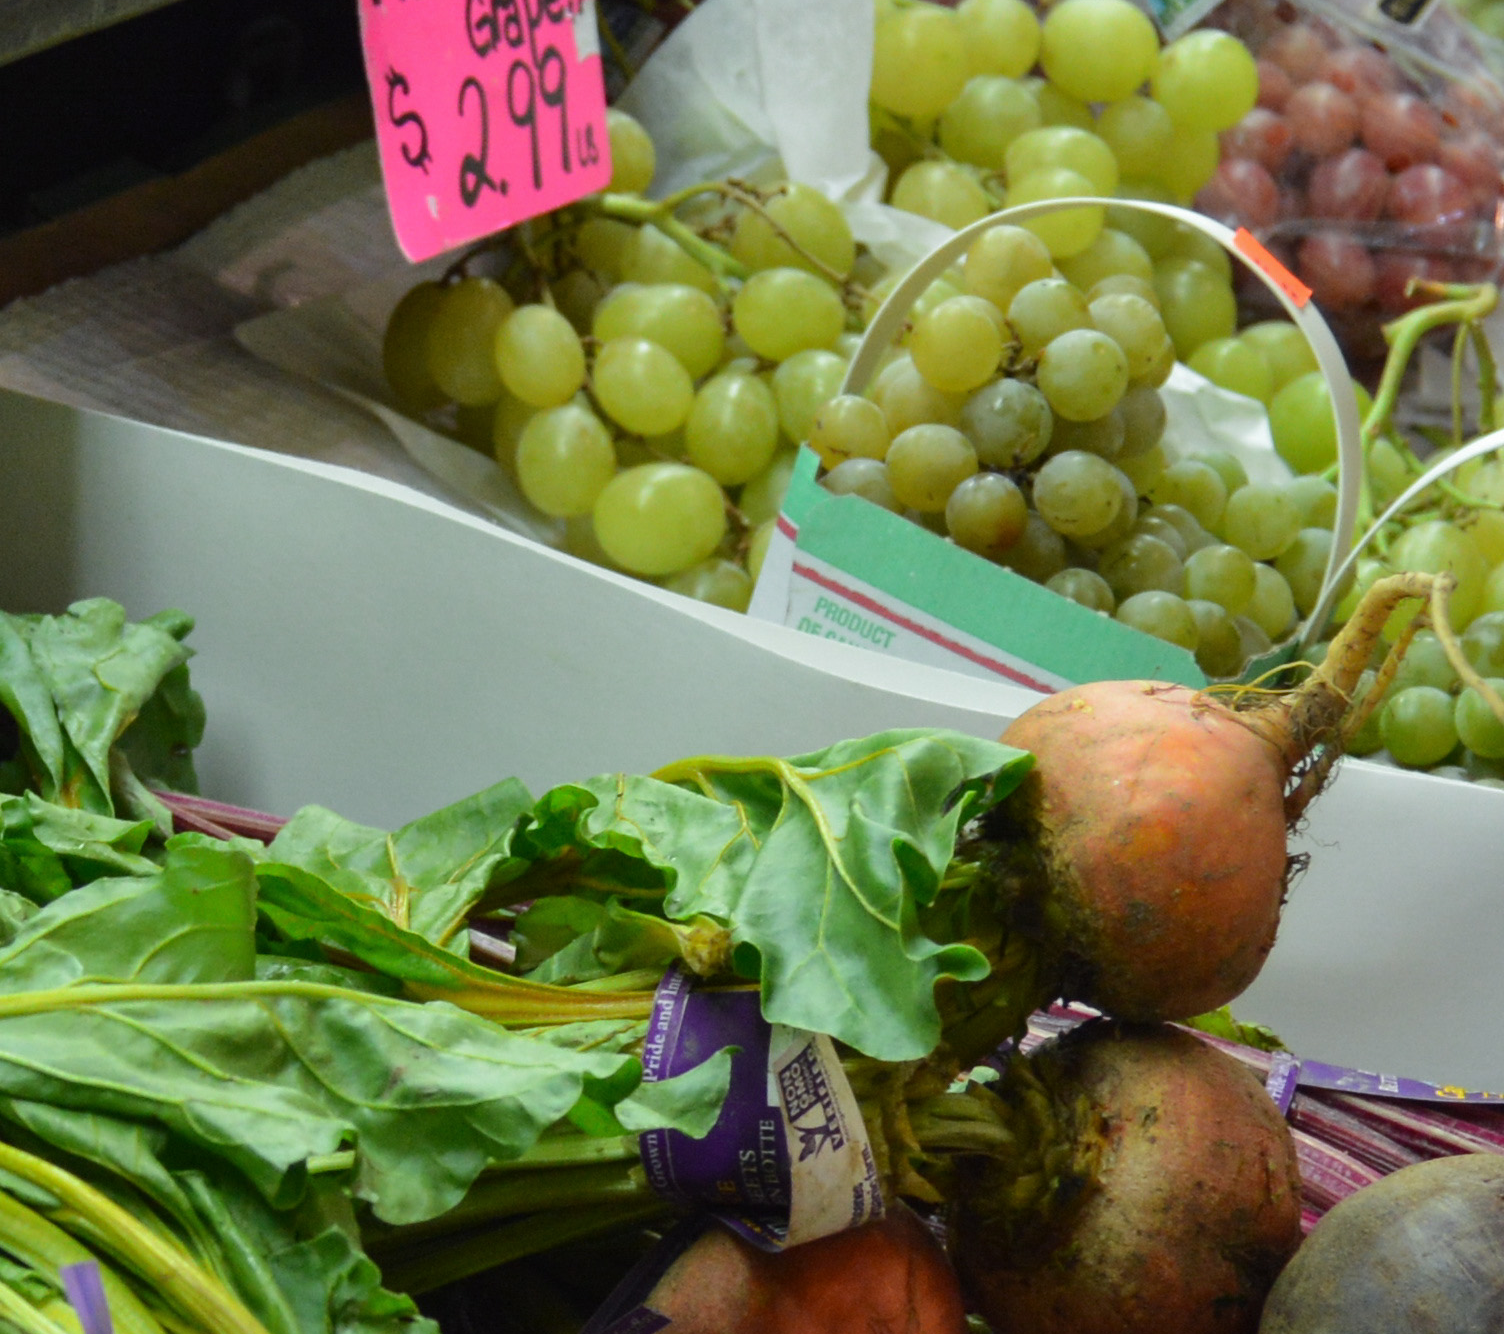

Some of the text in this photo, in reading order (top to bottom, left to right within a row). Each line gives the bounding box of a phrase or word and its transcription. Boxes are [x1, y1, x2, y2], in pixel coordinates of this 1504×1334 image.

[814, 596, 897, 649] PRODUCT
[642, 1033, 668, 1083] Pride
[657, 998, 676, 1032] and
[781, 1069, 803, 1119] NON
[791, 1060, 811, 1109] GMO
